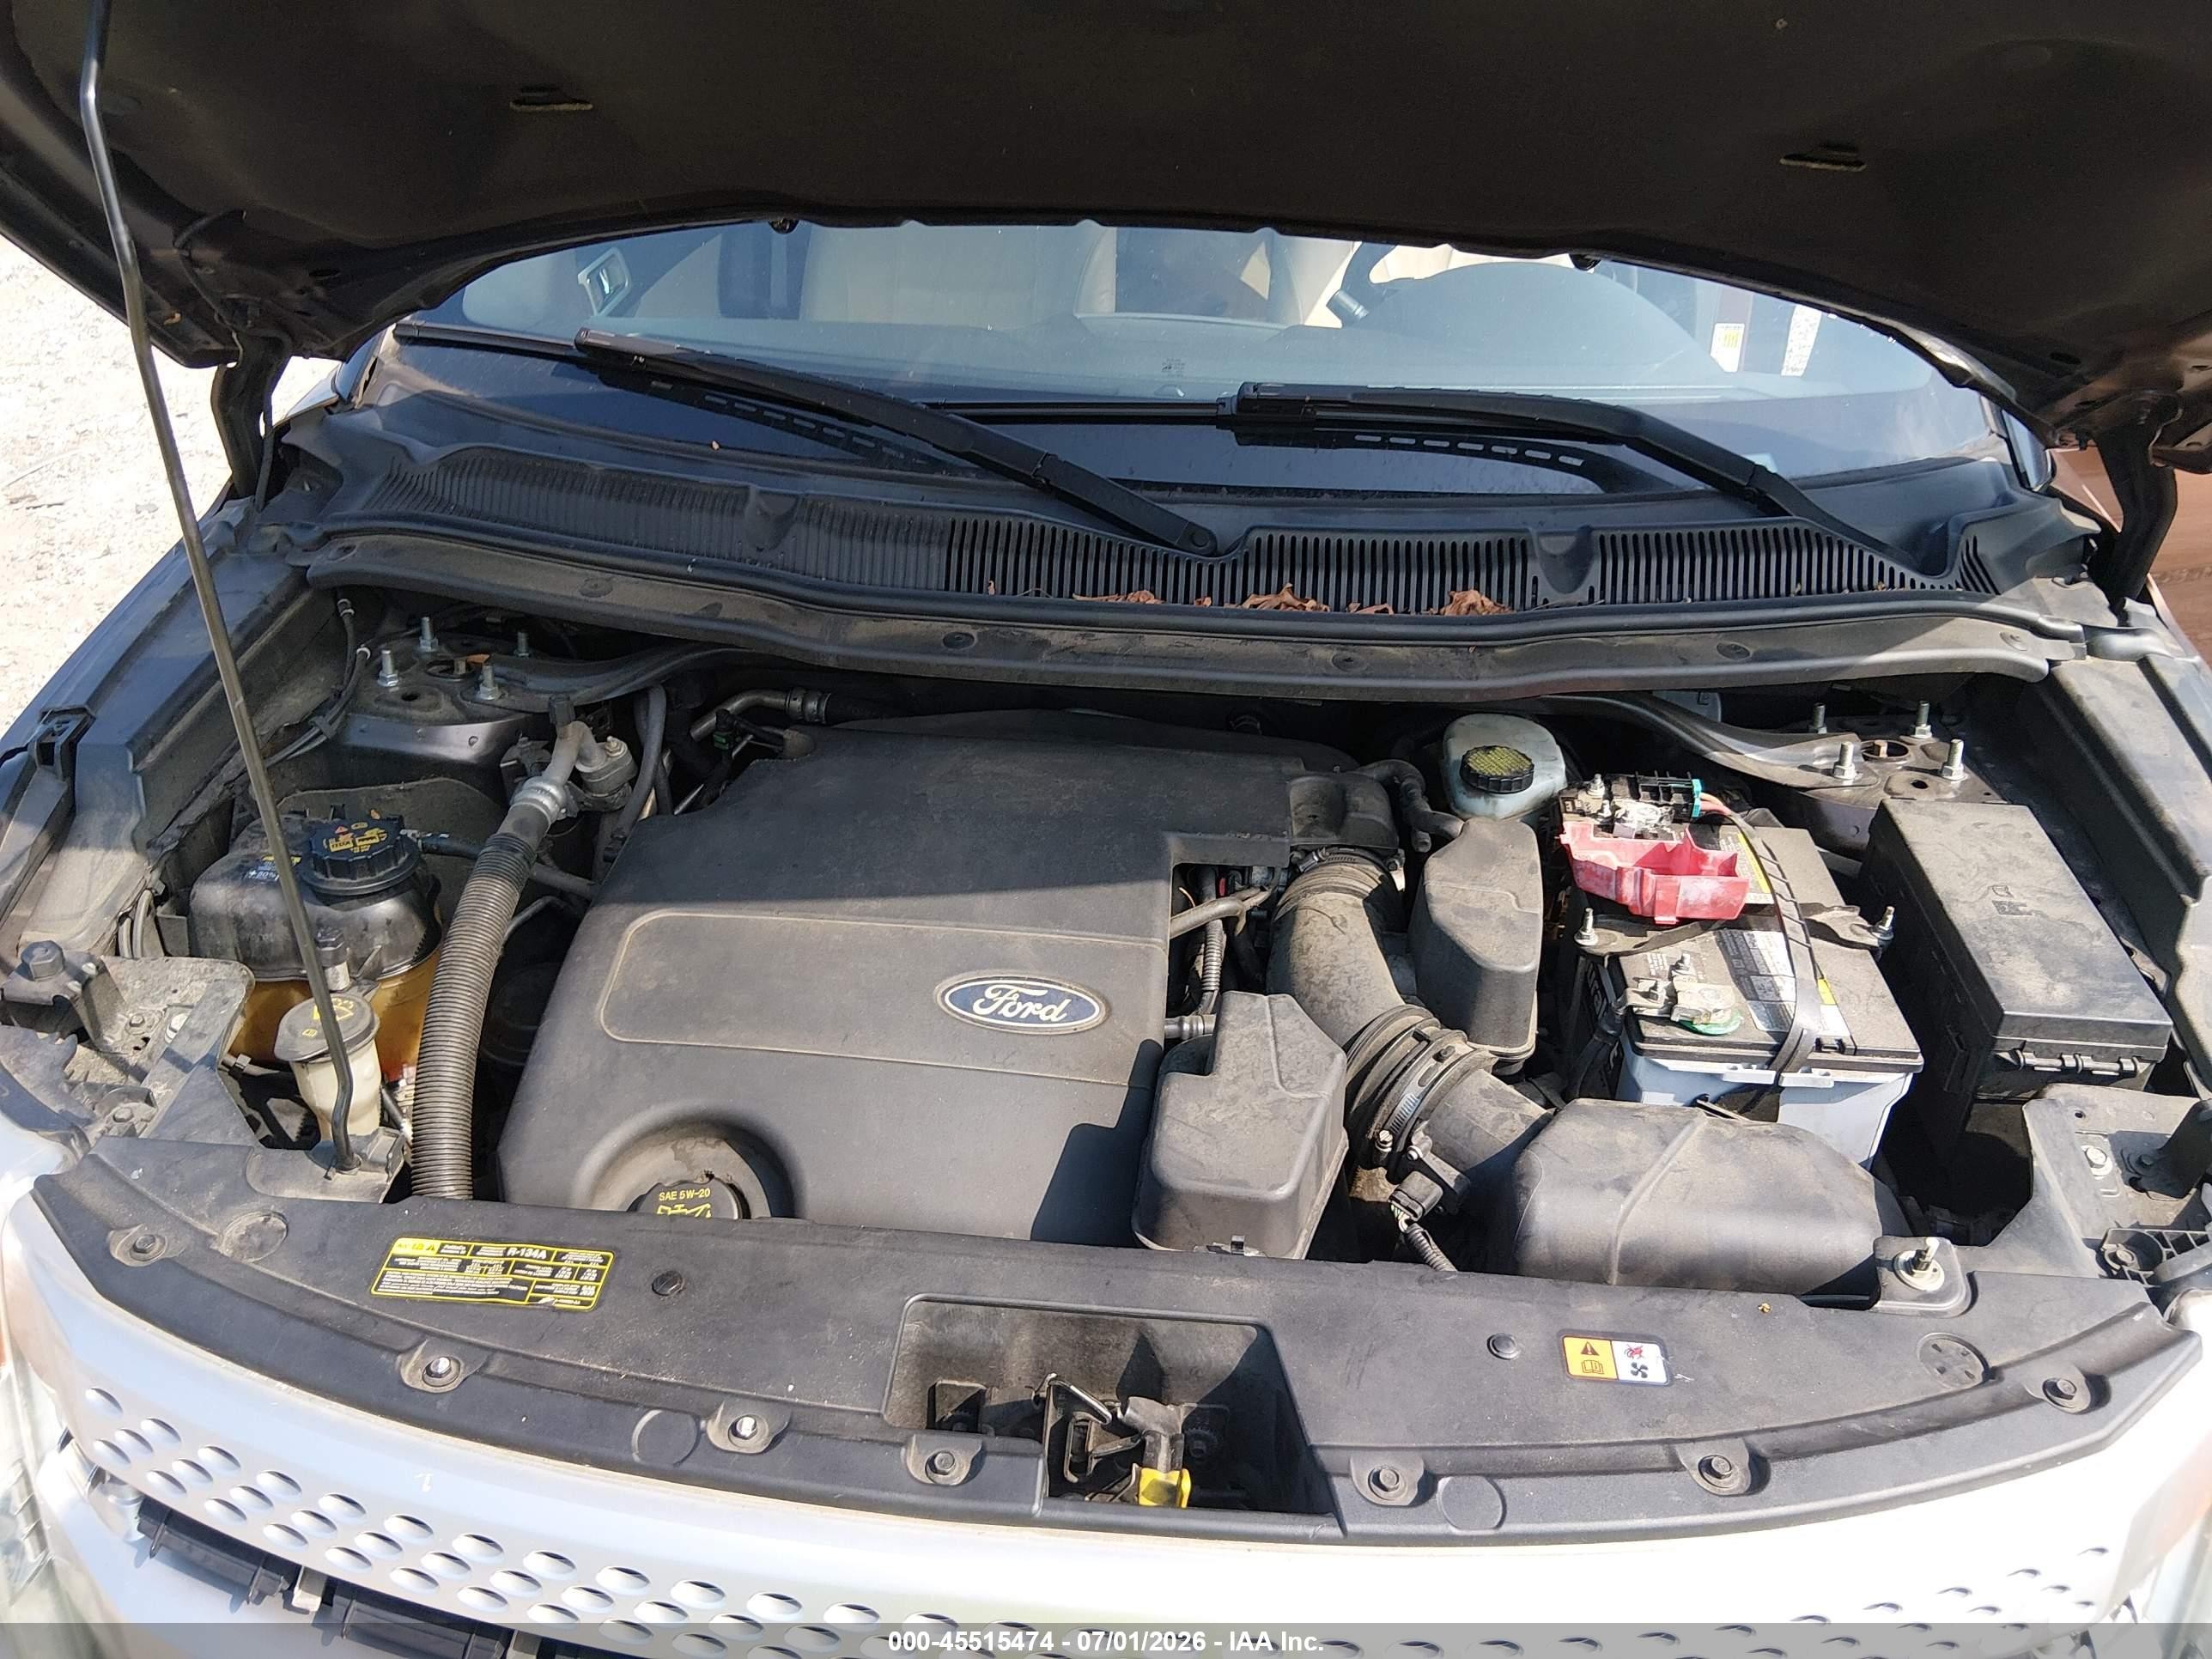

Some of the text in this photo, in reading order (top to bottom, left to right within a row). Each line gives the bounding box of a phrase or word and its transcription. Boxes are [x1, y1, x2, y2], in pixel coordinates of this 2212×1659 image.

[972, 983, 1072, 1022] Ford
[659, 1188, 711, 1201] SAE 5W-20
[506, 1247, 548, 1260] R-134A
